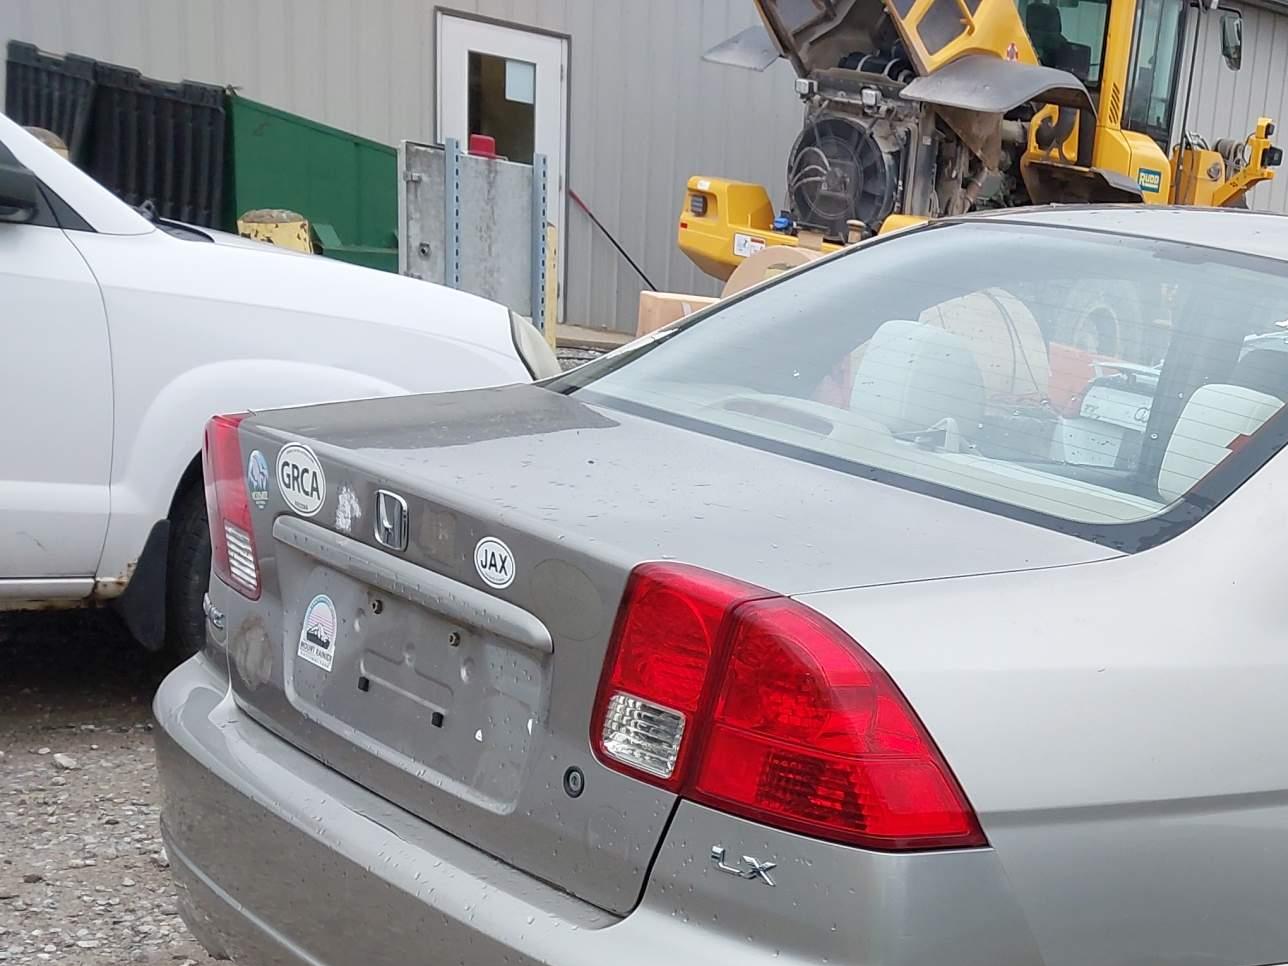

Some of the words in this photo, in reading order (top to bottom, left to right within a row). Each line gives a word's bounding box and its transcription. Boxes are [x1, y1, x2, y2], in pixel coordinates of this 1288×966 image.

[1139, 172, 1160, 187] RUDD
[281, 460, 321, 501] GRCA
[480, 549, 508, 577] JAX
[711, 846, 776, 887] LX
